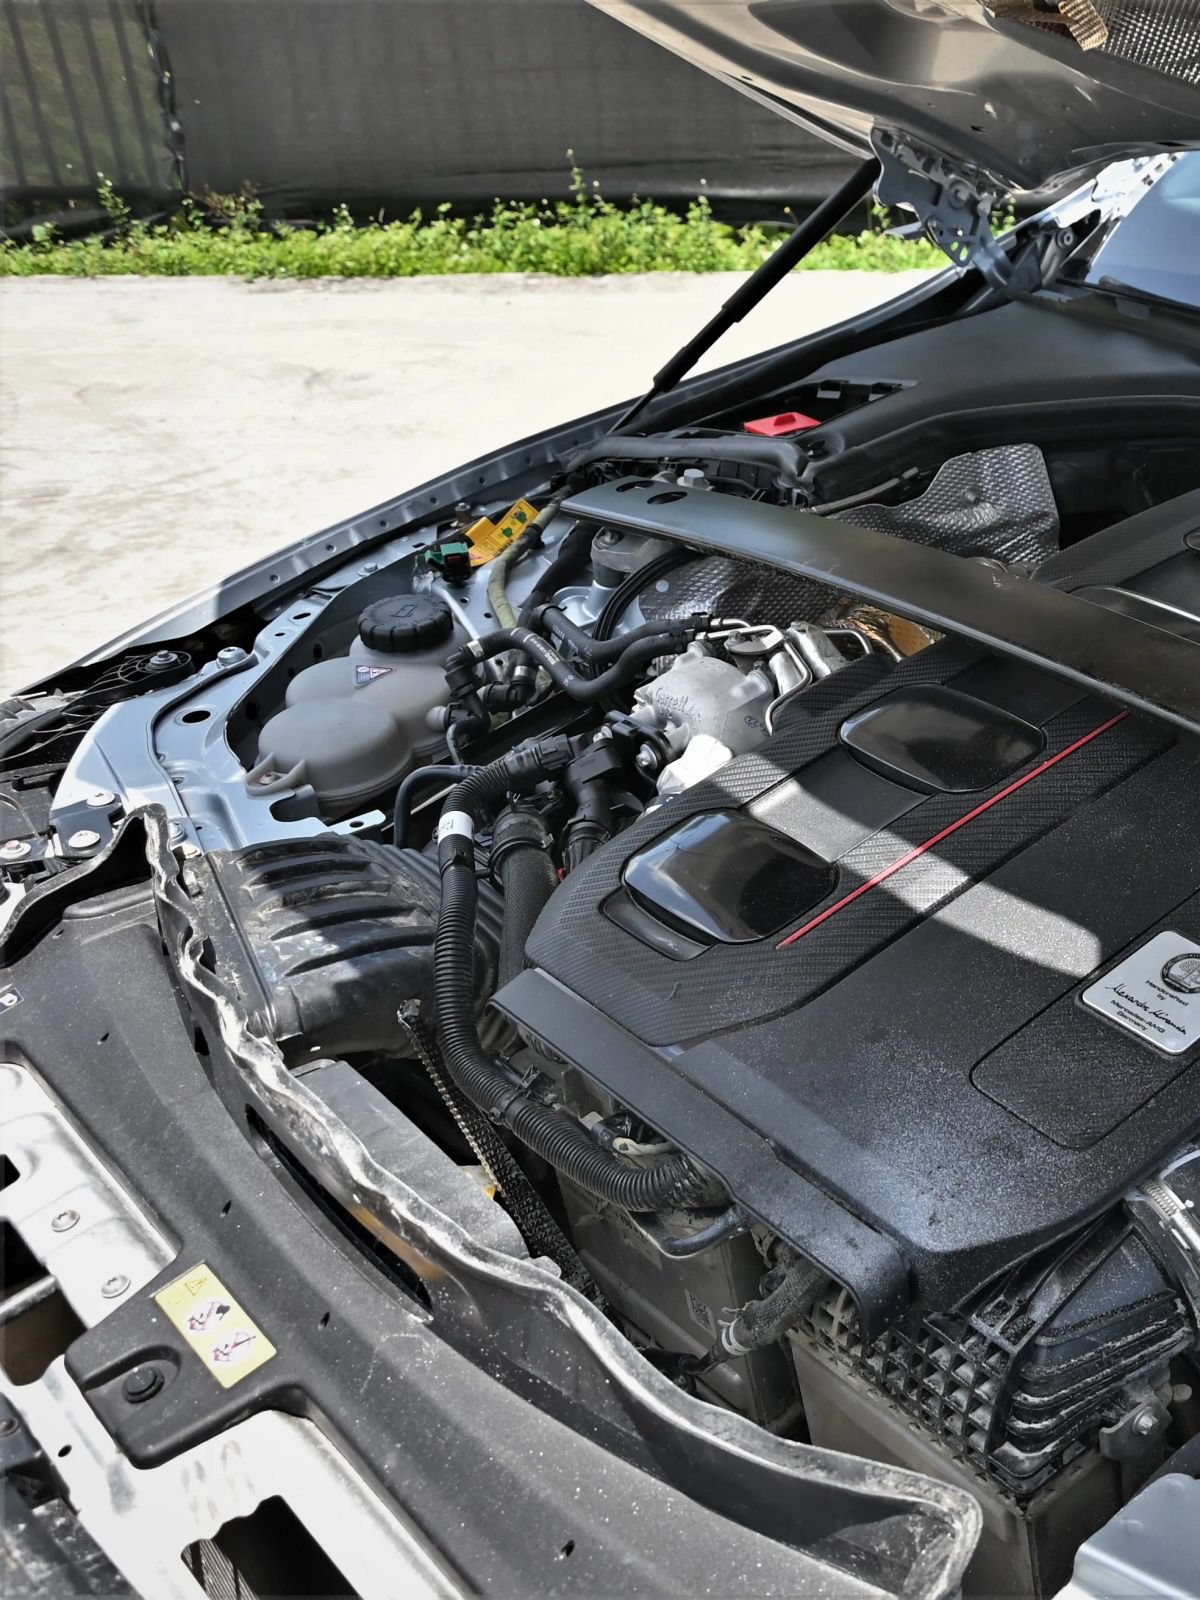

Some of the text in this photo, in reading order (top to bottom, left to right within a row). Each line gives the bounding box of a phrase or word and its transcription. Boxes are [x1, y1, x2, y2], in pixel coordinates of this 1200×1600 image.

[1145, 979, 1189, 1007] Handcrafted
[1157, 992, 1166, 1001] by
[1110, 999, 1166, 1034] Mercedes-AMG
[1117, 1010, 1148, 1032] Germany
